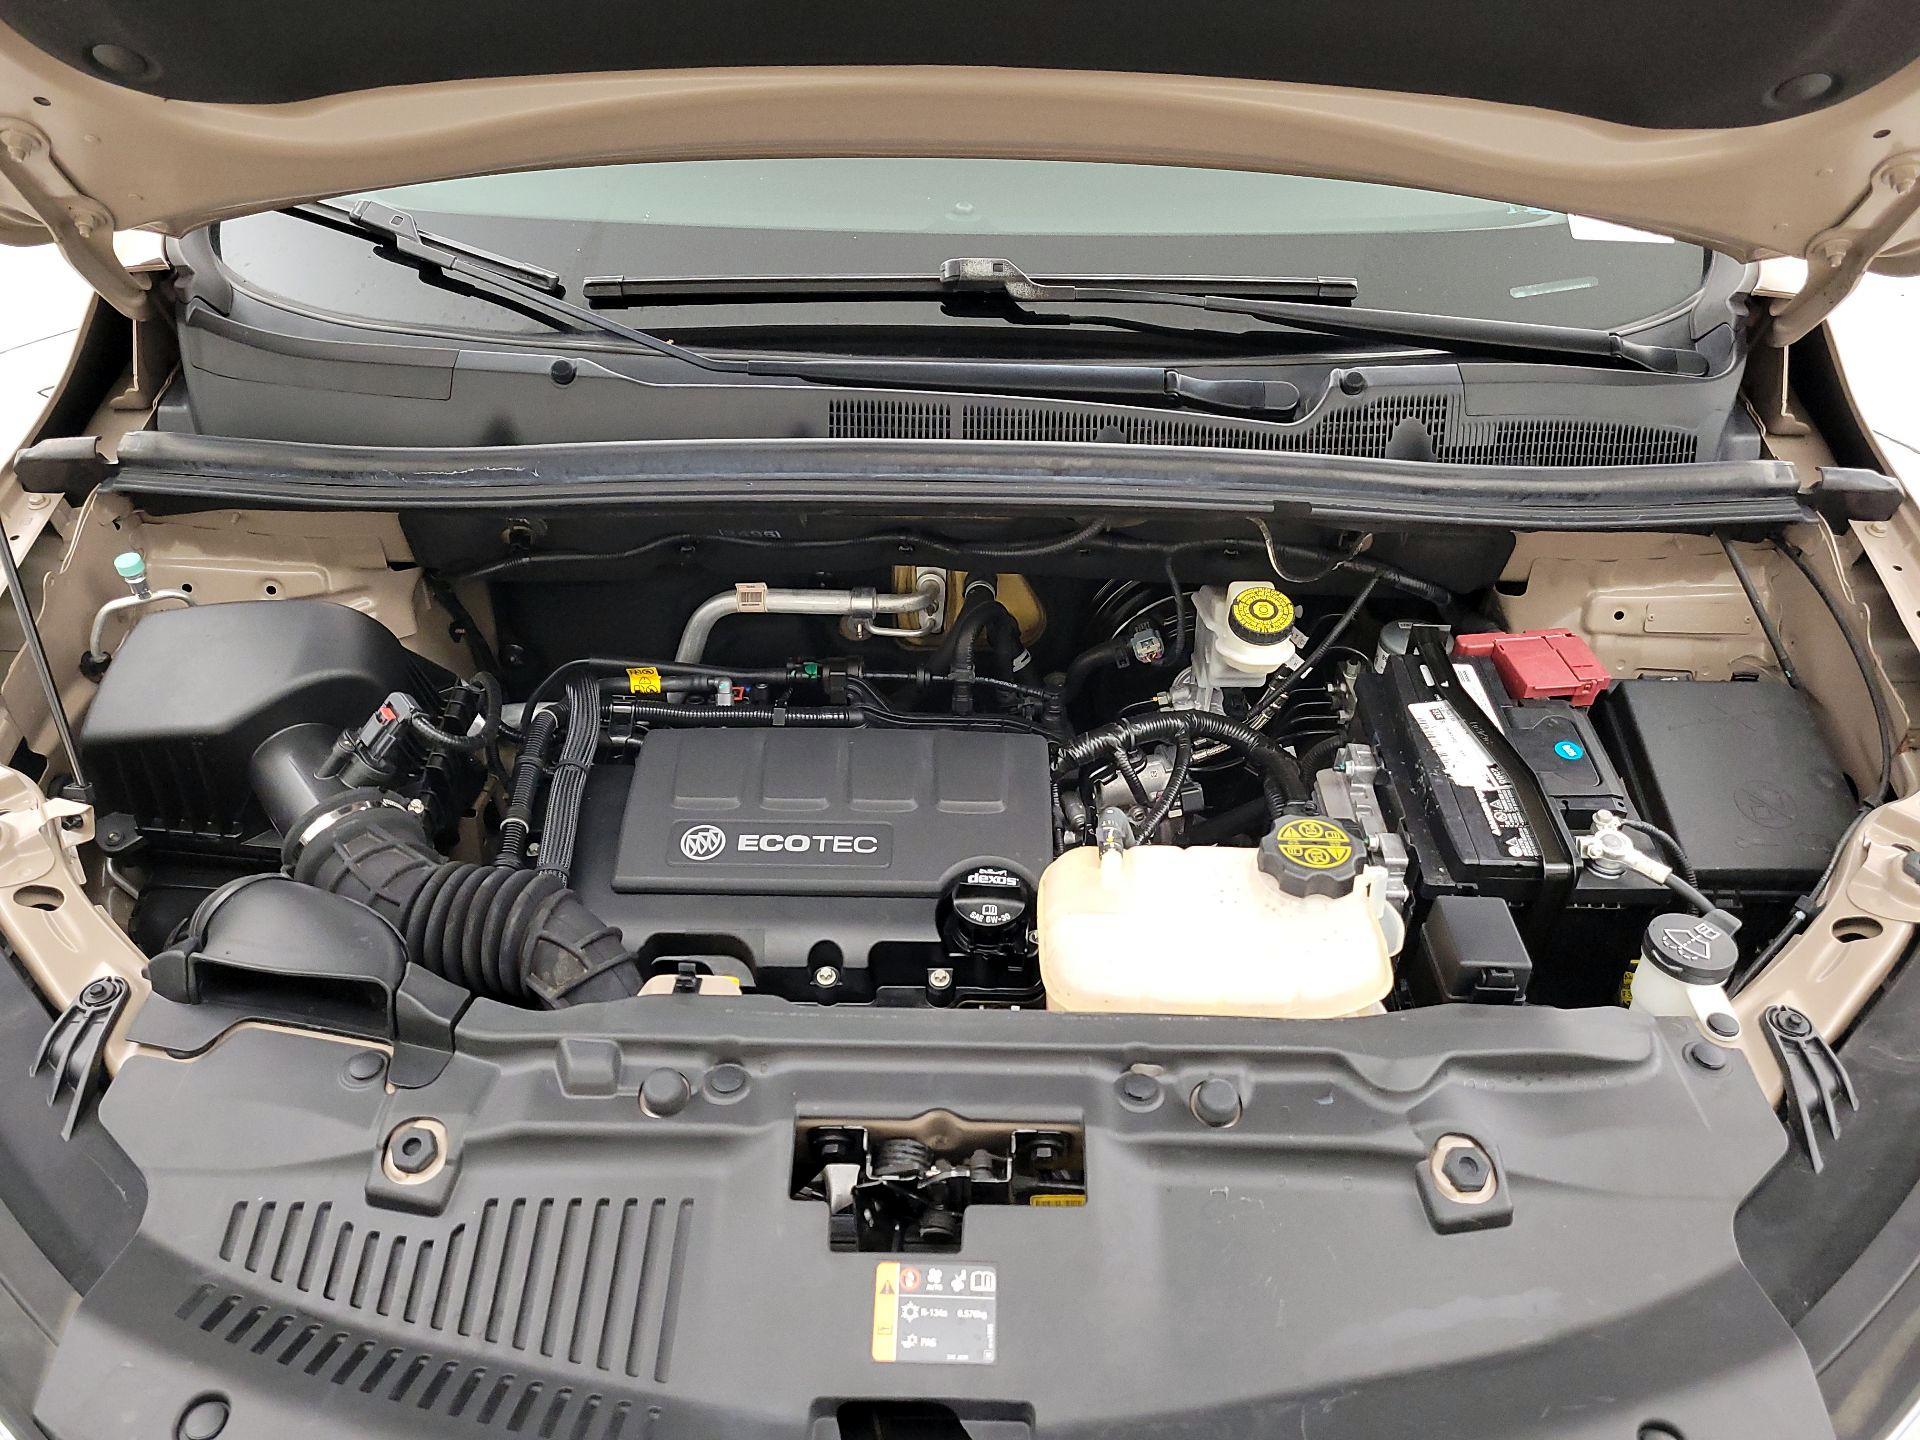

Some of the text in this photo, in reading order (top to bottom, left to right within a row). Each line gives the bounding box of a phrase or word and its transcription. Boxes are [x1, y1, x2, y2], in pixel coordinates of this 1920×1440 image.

[737, 834, 878, 854] ECOTEC
[967, 872, 1017, 886] dexos
[969, 911, 985, 922] SAE
